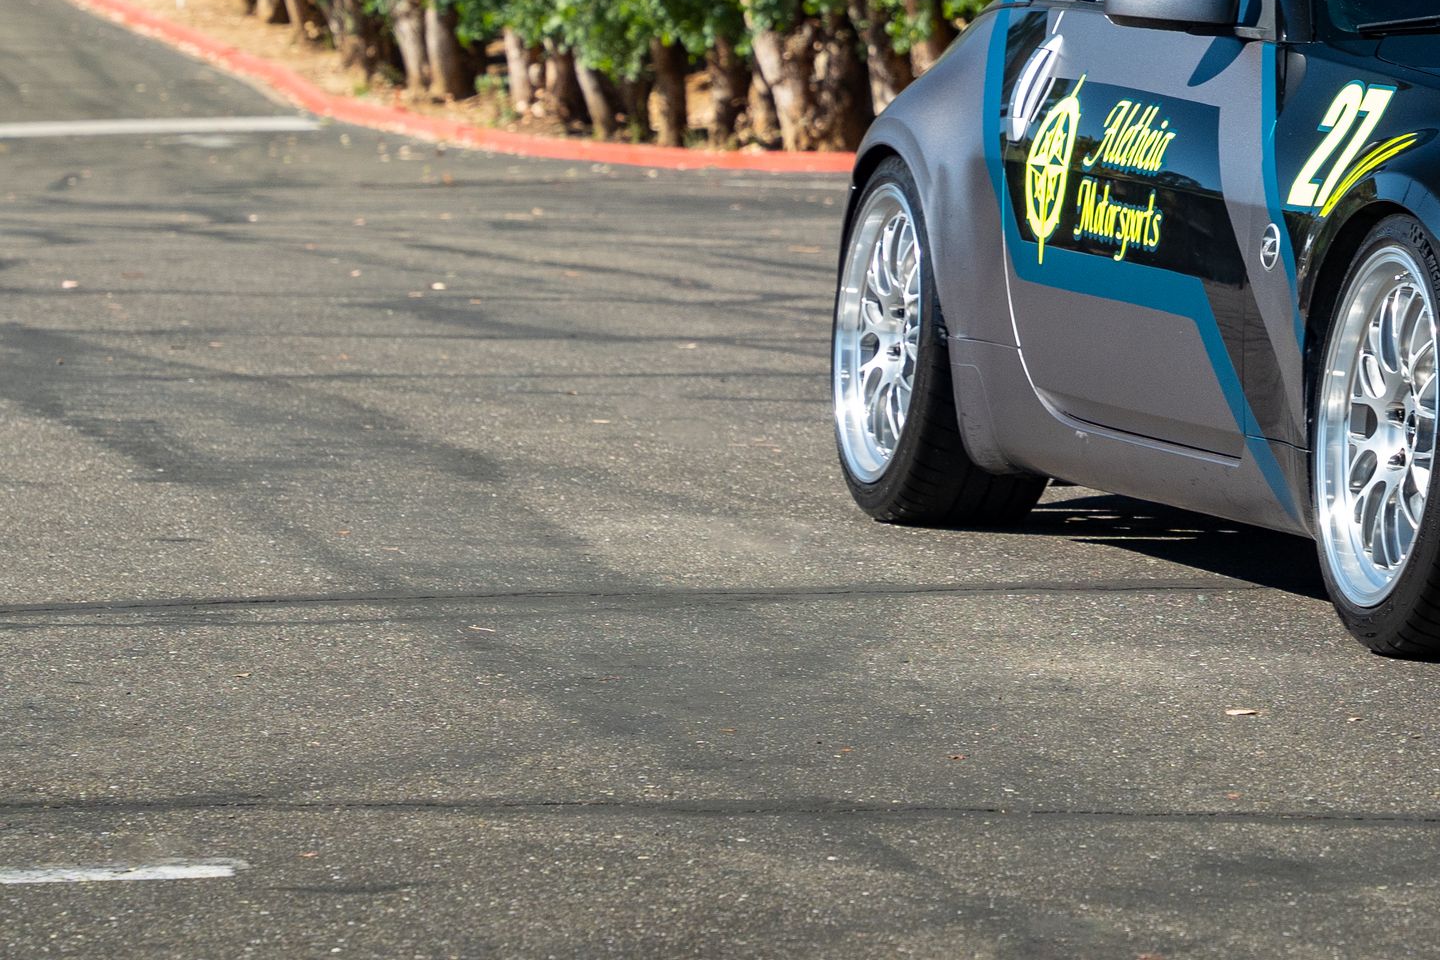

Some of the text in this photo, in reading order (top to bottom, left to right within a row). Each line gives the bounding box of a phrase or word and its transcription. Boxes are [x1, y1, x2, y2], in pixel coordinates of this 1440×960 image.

[1083, 99, 1176, 173] Aletheia
[1284, 80, 1397, 210] 27
[1073, 179, 1163, 261] Motorsports
